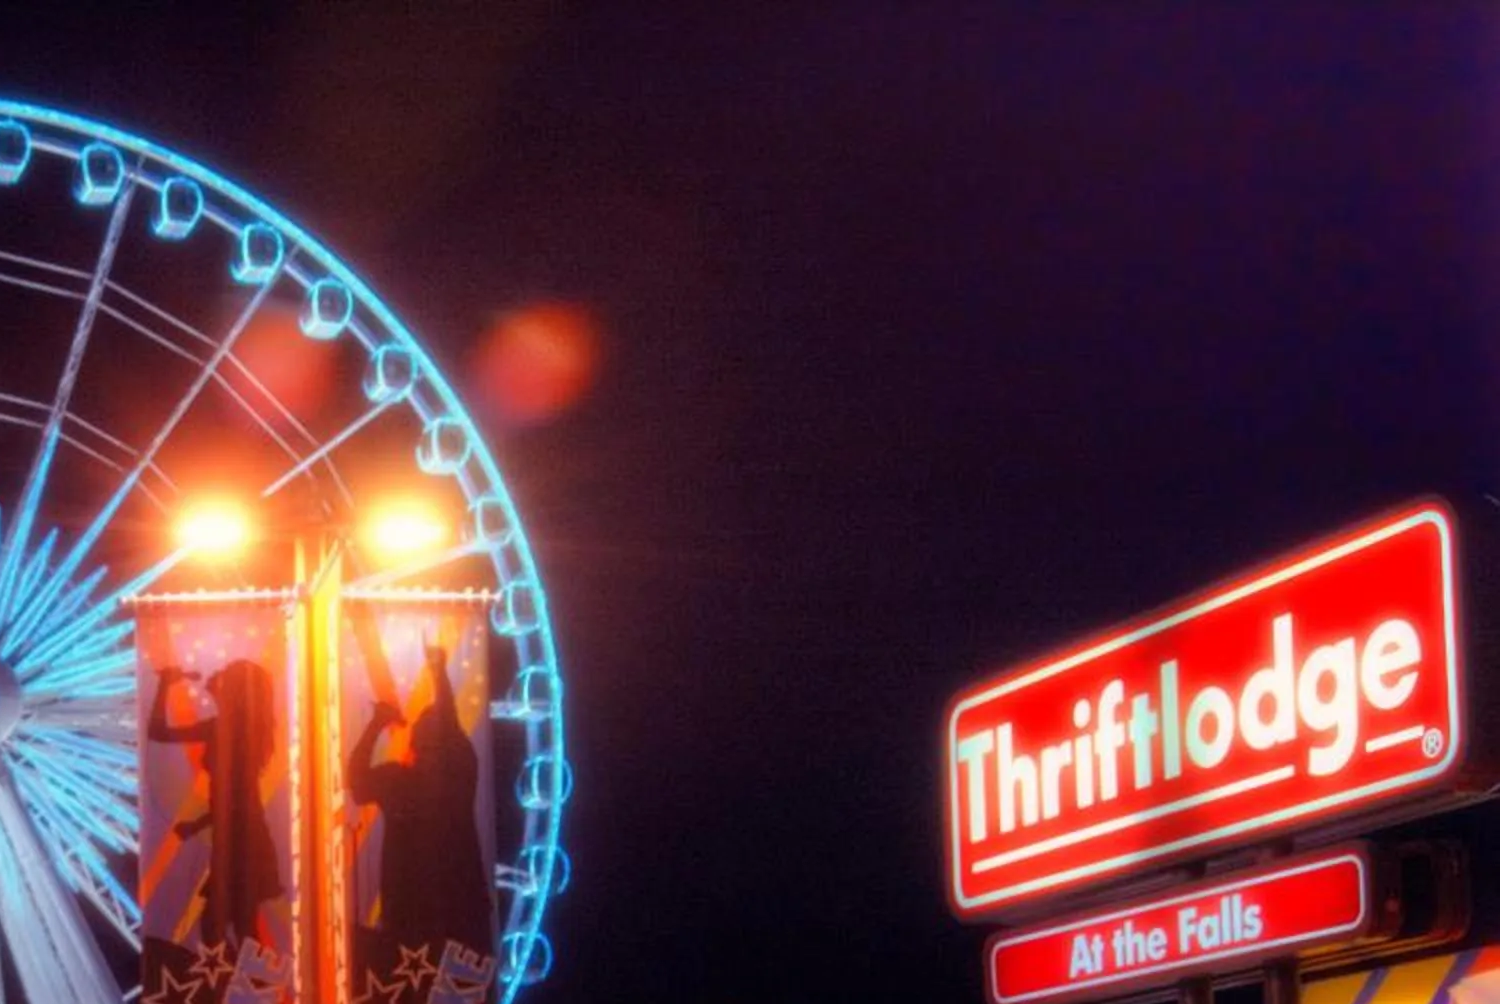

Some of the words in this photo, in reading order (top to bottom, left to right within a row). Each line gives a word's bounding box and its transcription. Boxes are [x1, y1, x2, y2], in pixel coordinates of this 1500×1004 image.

[957, 612, 1422, 844] Thriftlodge
[1068, 933, 1106, 978] At
[1113, 921, 1167, 967] the
[1178, 893, 1264, 954] Falls
